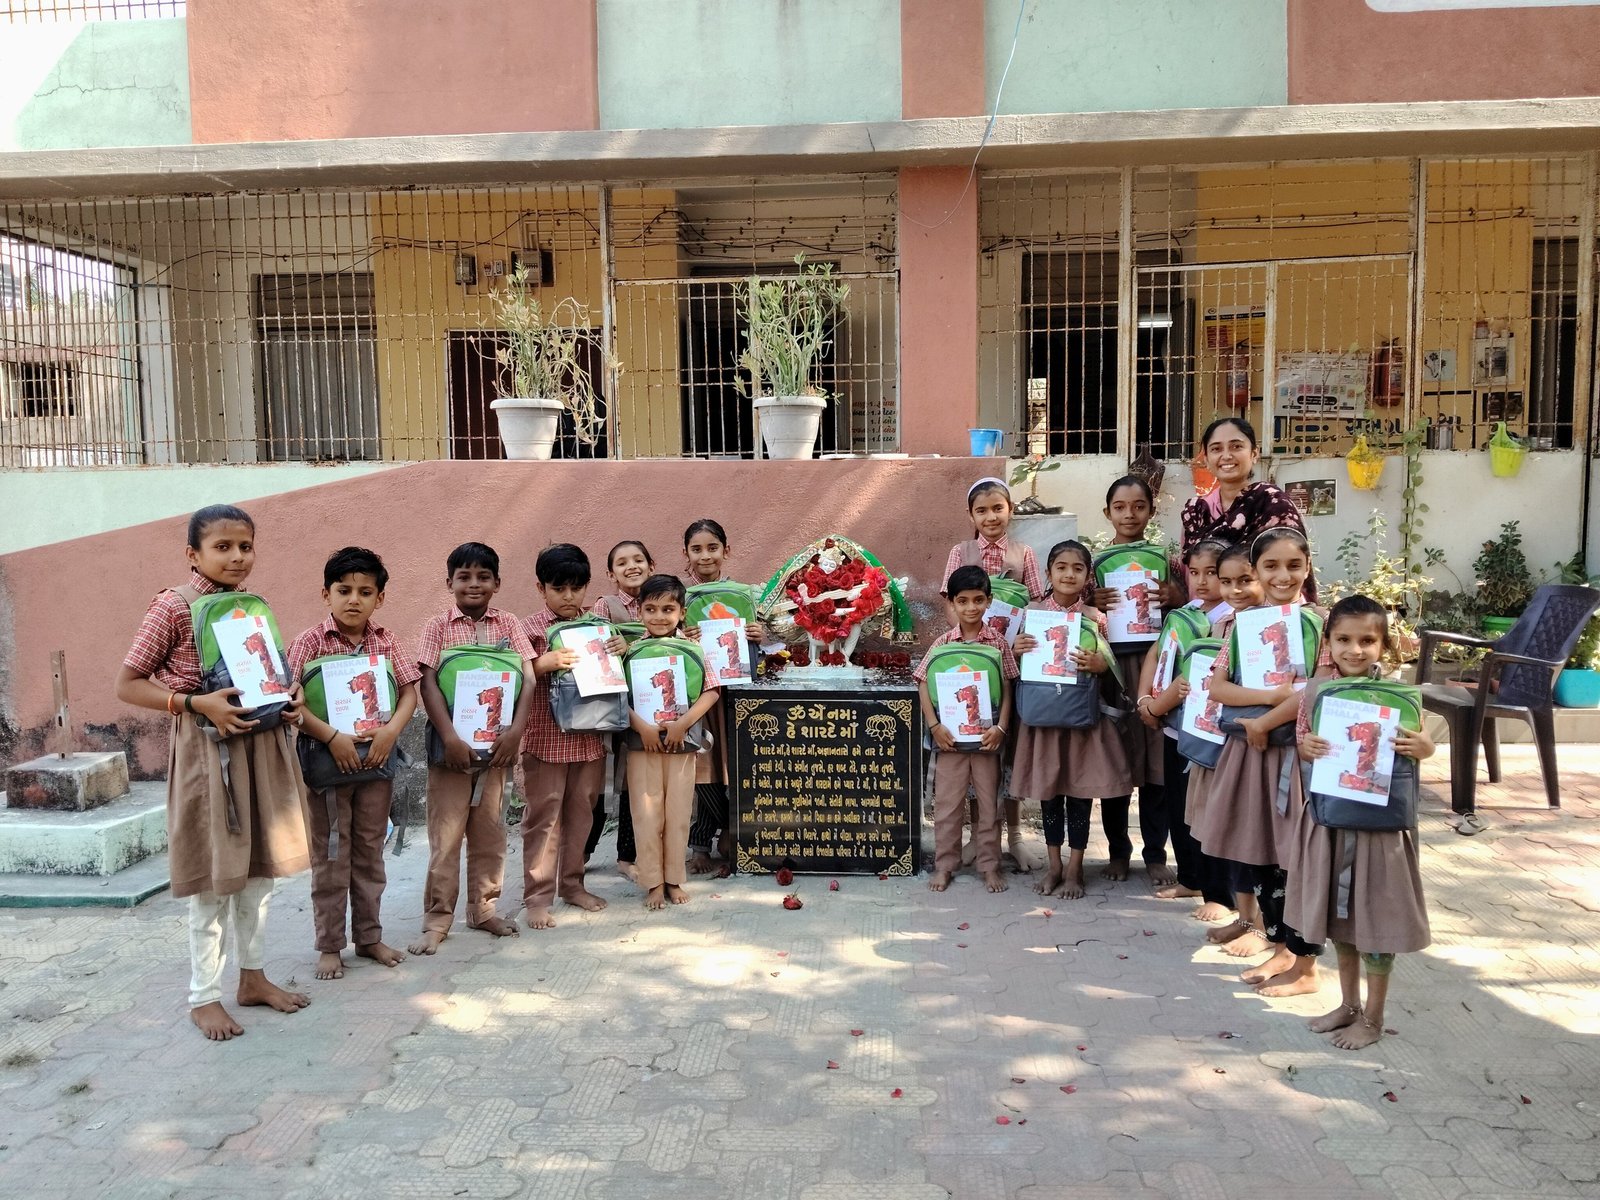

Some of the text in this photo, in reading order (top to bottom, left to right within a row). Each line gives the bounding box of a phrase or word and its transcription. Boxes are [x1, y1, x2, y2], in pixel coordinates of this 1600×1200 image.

[786, 721, 796, 739] હે
[801, 721, 837, 738] શારદે
[760, 743, 775, 756] શારદે
[791, 743, 806, 756] શારદે
